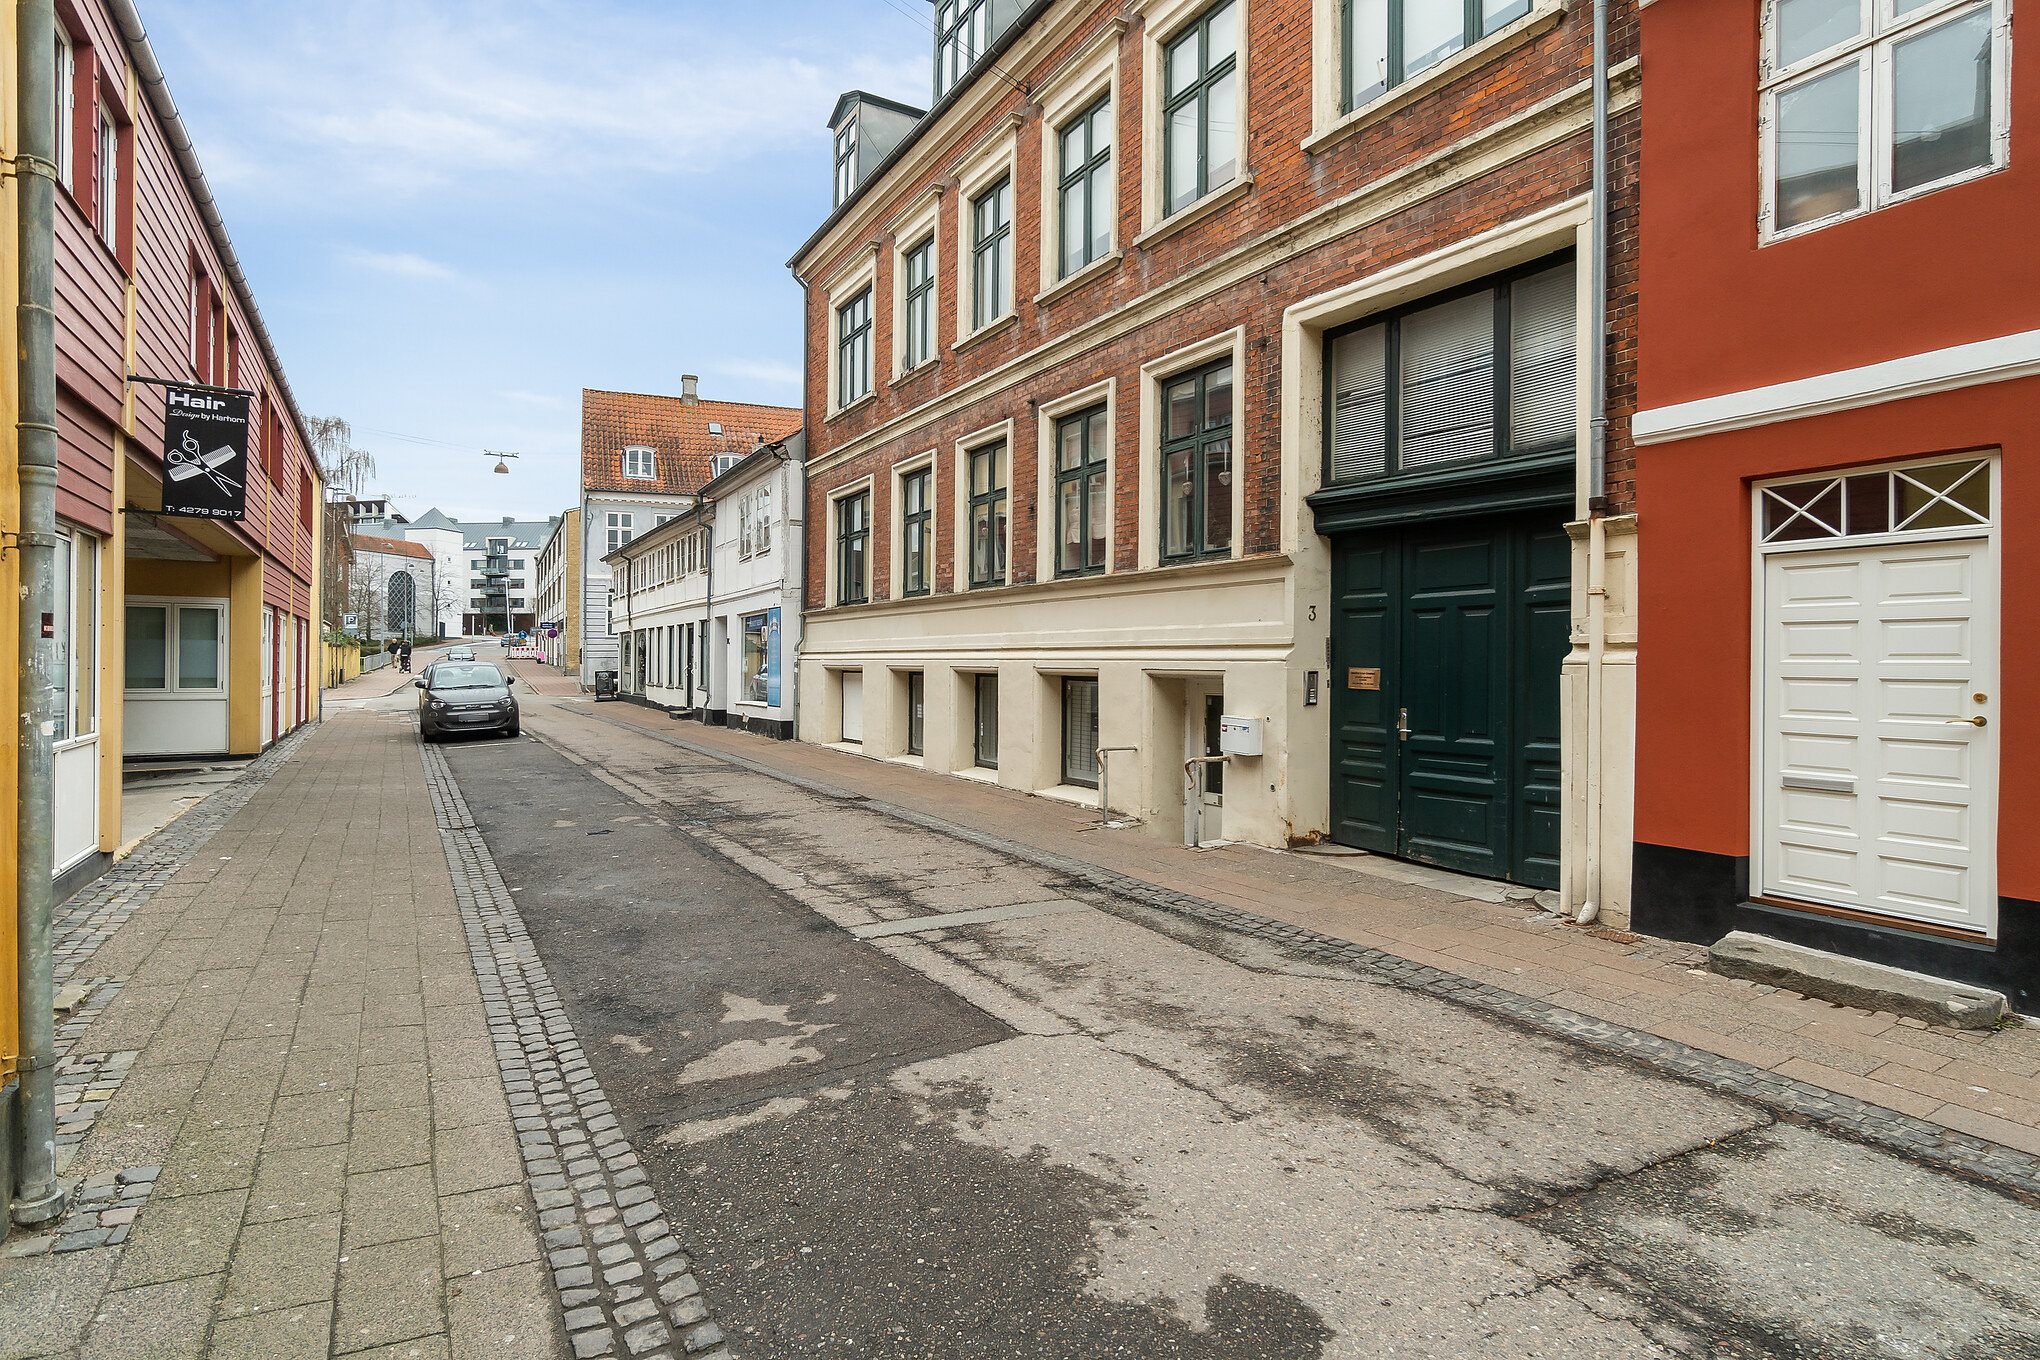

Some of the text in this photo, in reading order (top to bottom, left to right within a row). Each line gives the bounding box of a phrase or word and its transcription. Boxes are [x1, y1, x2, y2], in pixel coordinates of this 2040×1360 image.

[169, 391, 226, 410] Hair
[169, 408, 200, 420] Design
[200, 412, 211, 421] by
[179, 506, 209, 515] 4279
[212, 508, 242, 517] 9017
[1308, 605, 1317, 622] 3
